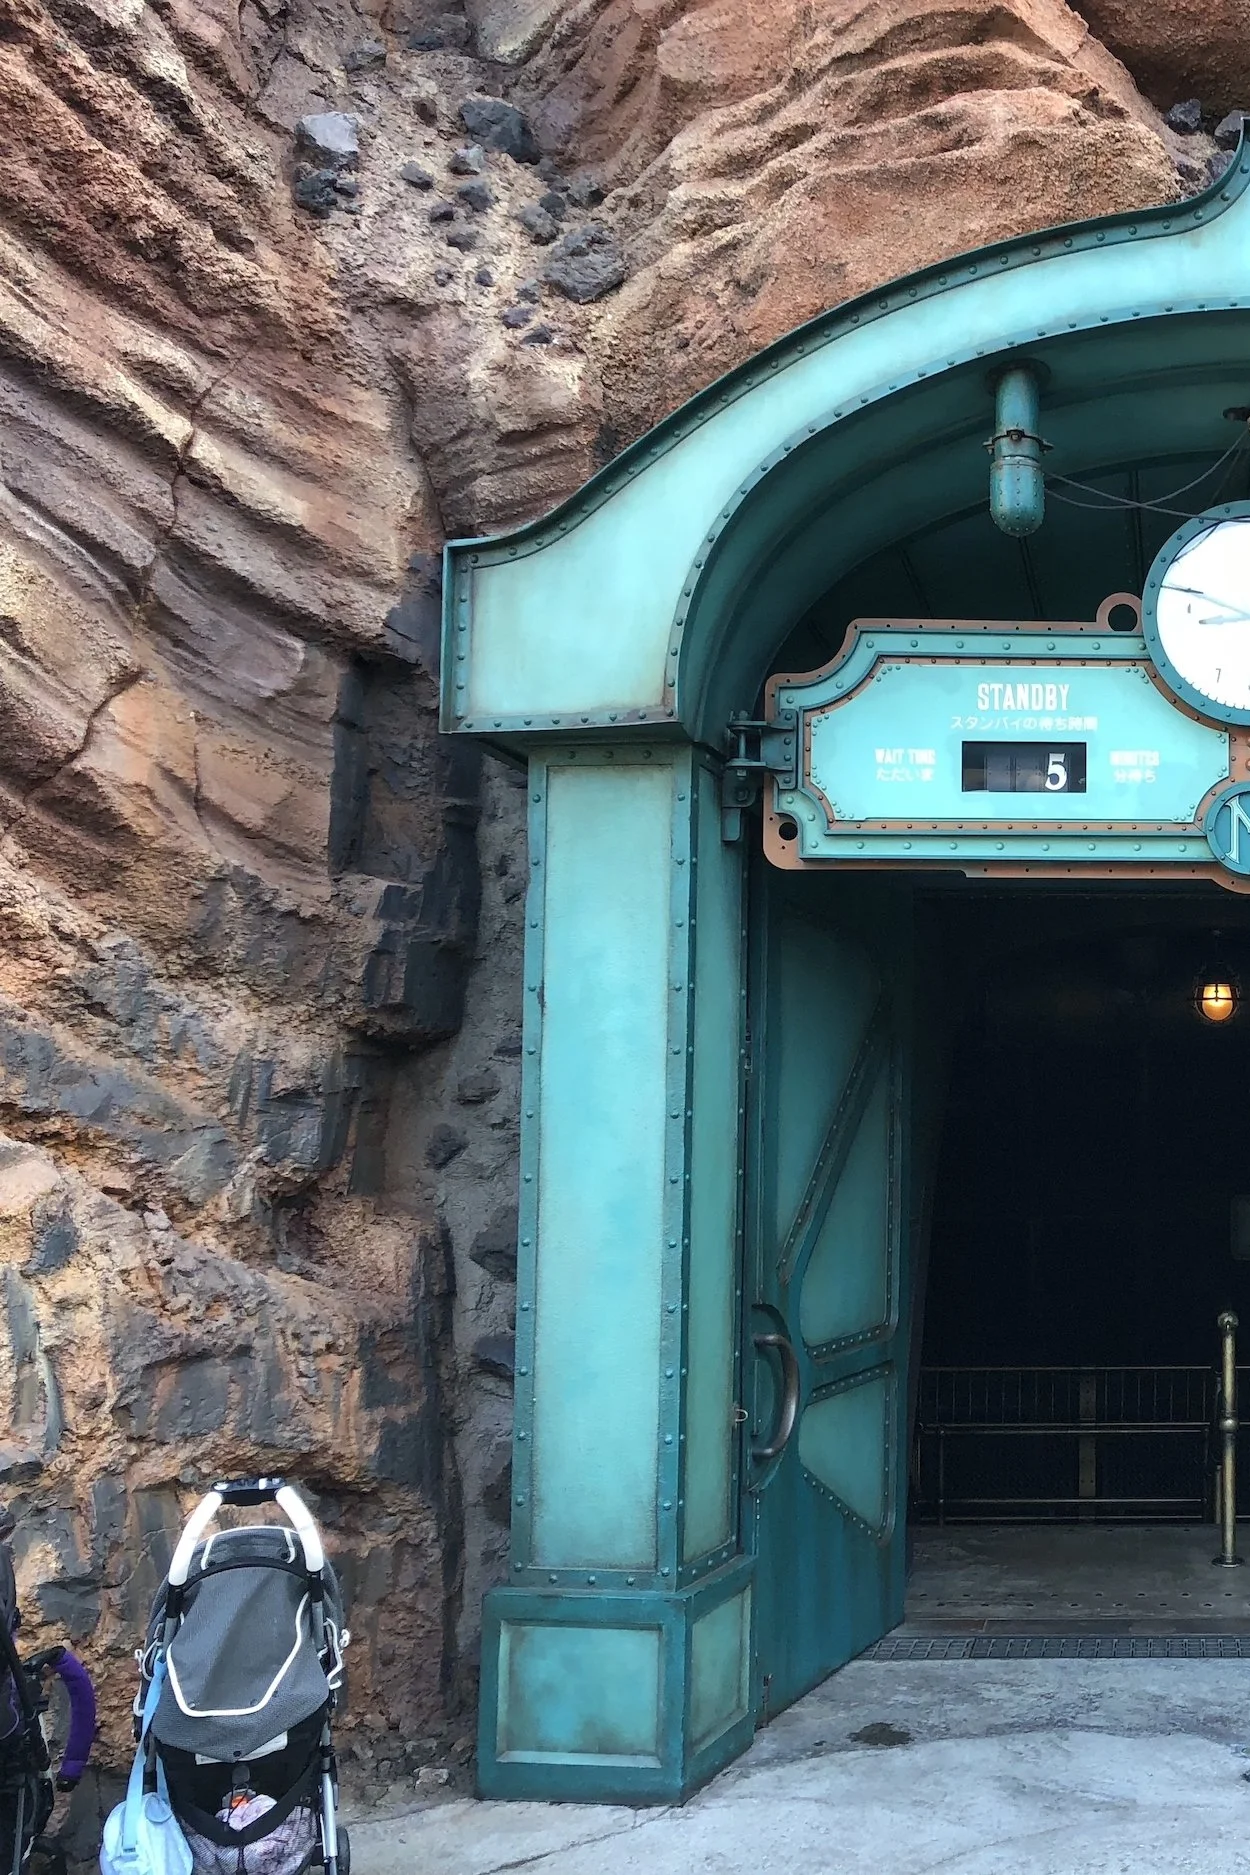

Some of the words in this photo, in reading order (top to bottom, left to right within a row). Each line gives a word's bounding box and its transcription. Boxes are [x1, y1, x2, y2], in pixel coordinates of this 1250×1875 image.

[977, 683, 1070, 711] STANDBY
[874, 748, 904, 764] WAIT
[1045, 752, 1068, 791] 5
